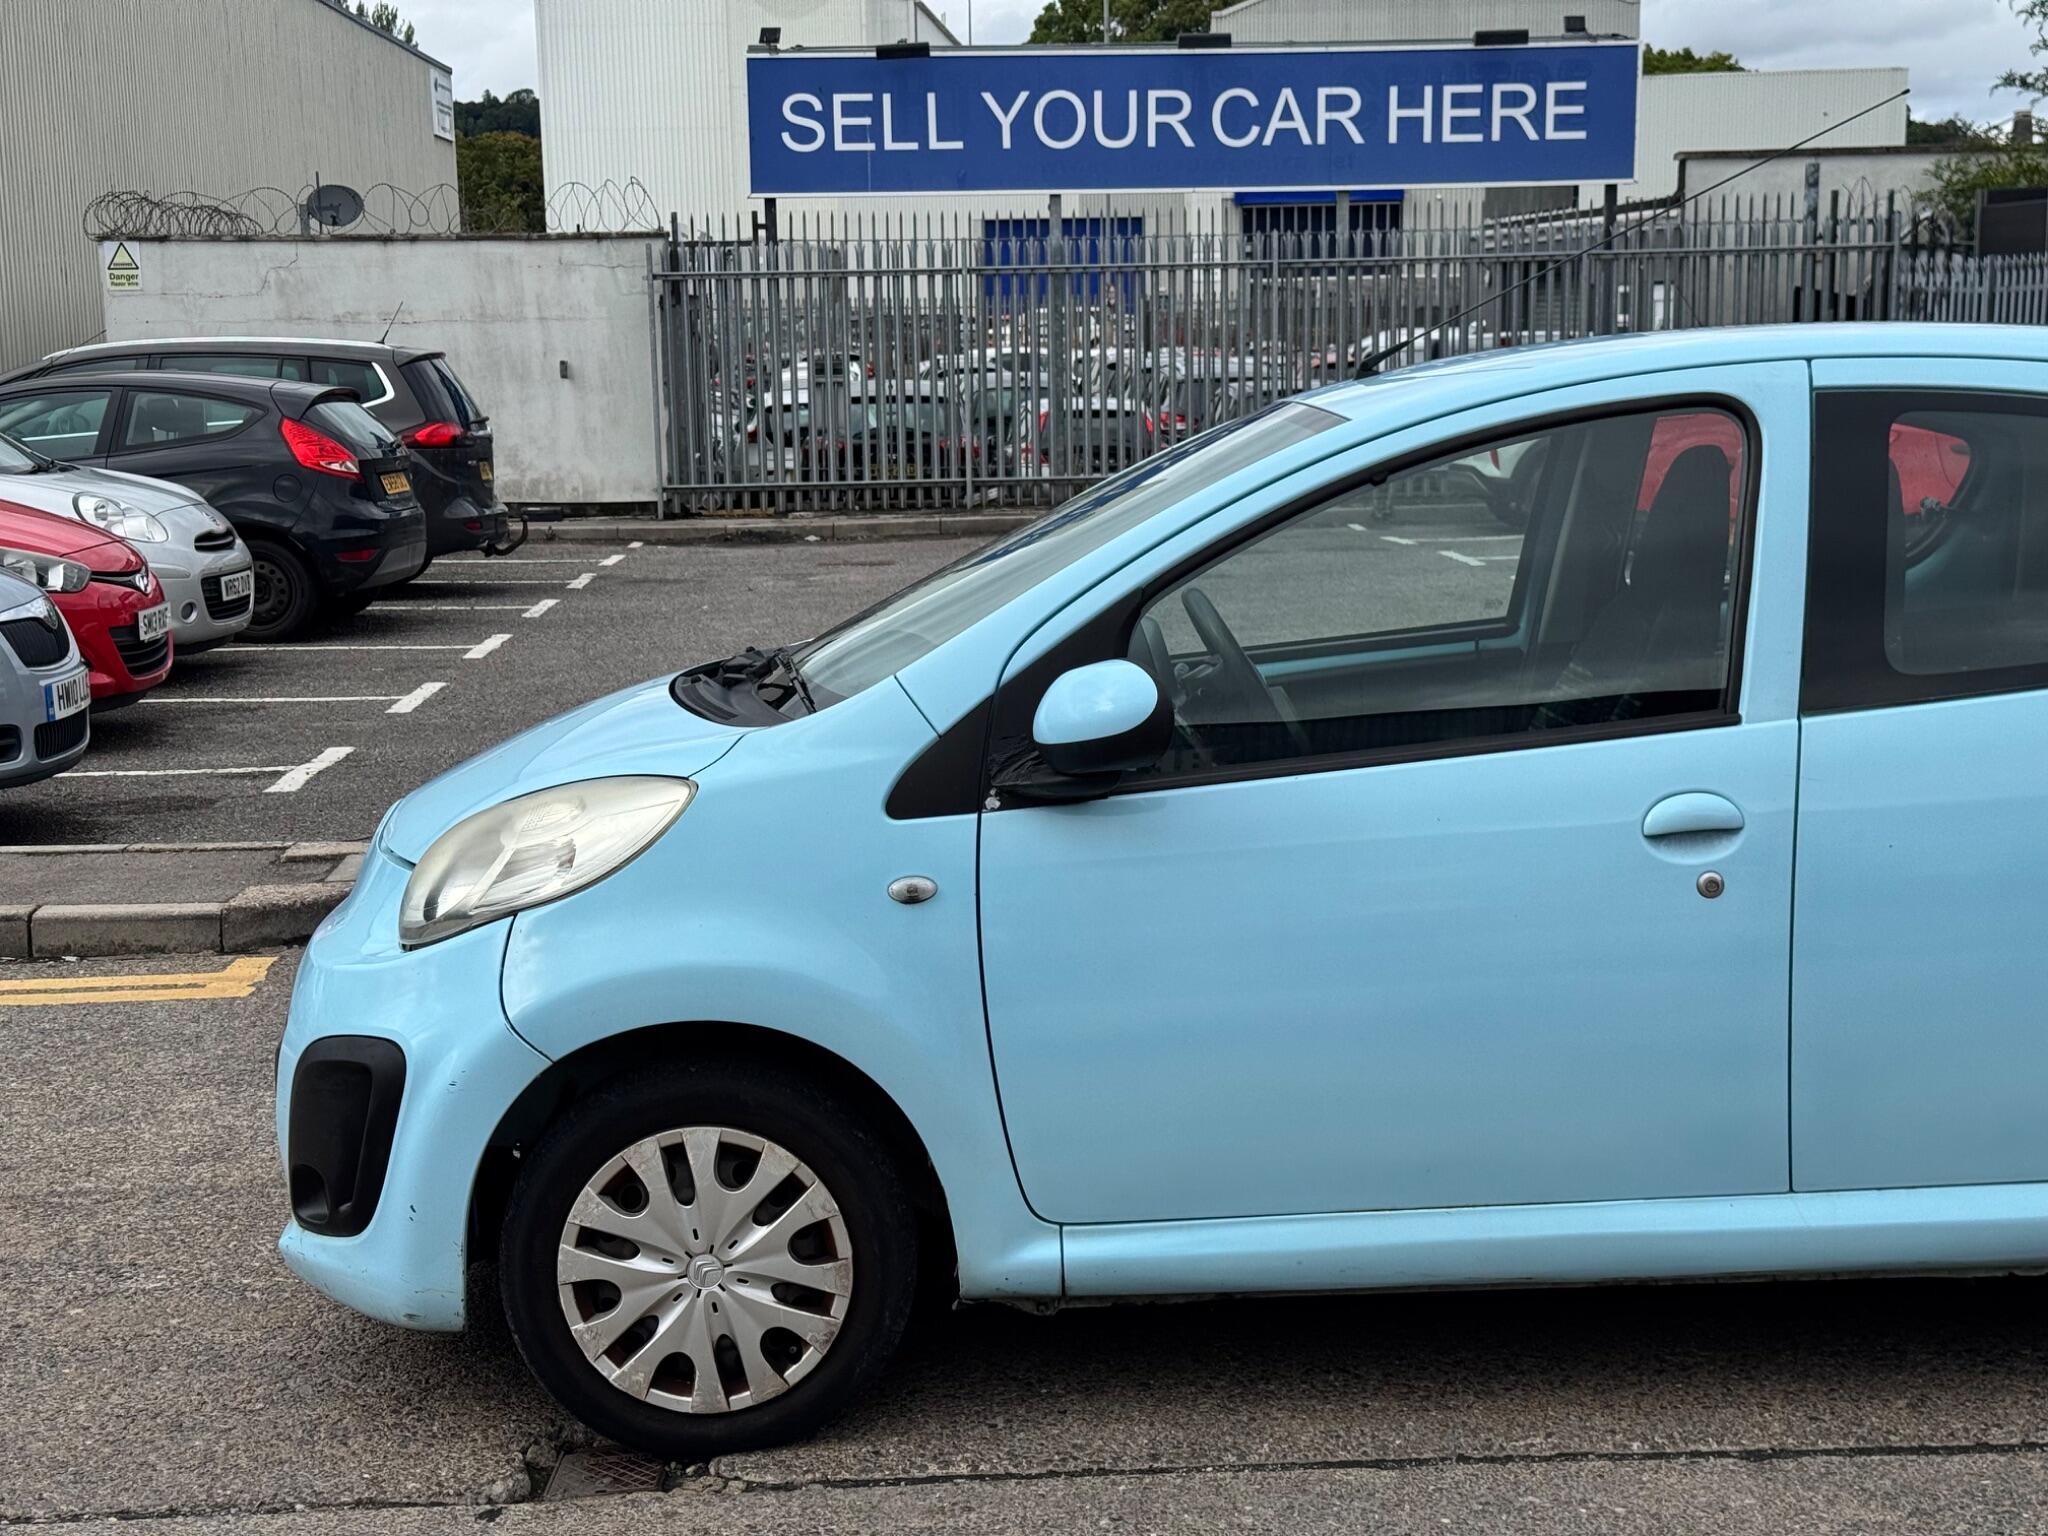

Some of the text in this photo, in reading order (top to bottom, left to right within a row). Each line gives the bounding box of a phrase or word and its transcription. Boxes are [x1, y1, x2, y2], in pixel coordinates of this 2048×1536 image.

[780, 80, 1588, 153] SELL YOUR CAR HERE
[109, 272, 138, 281] Danger
[56, 679, 79, 711] HW10
